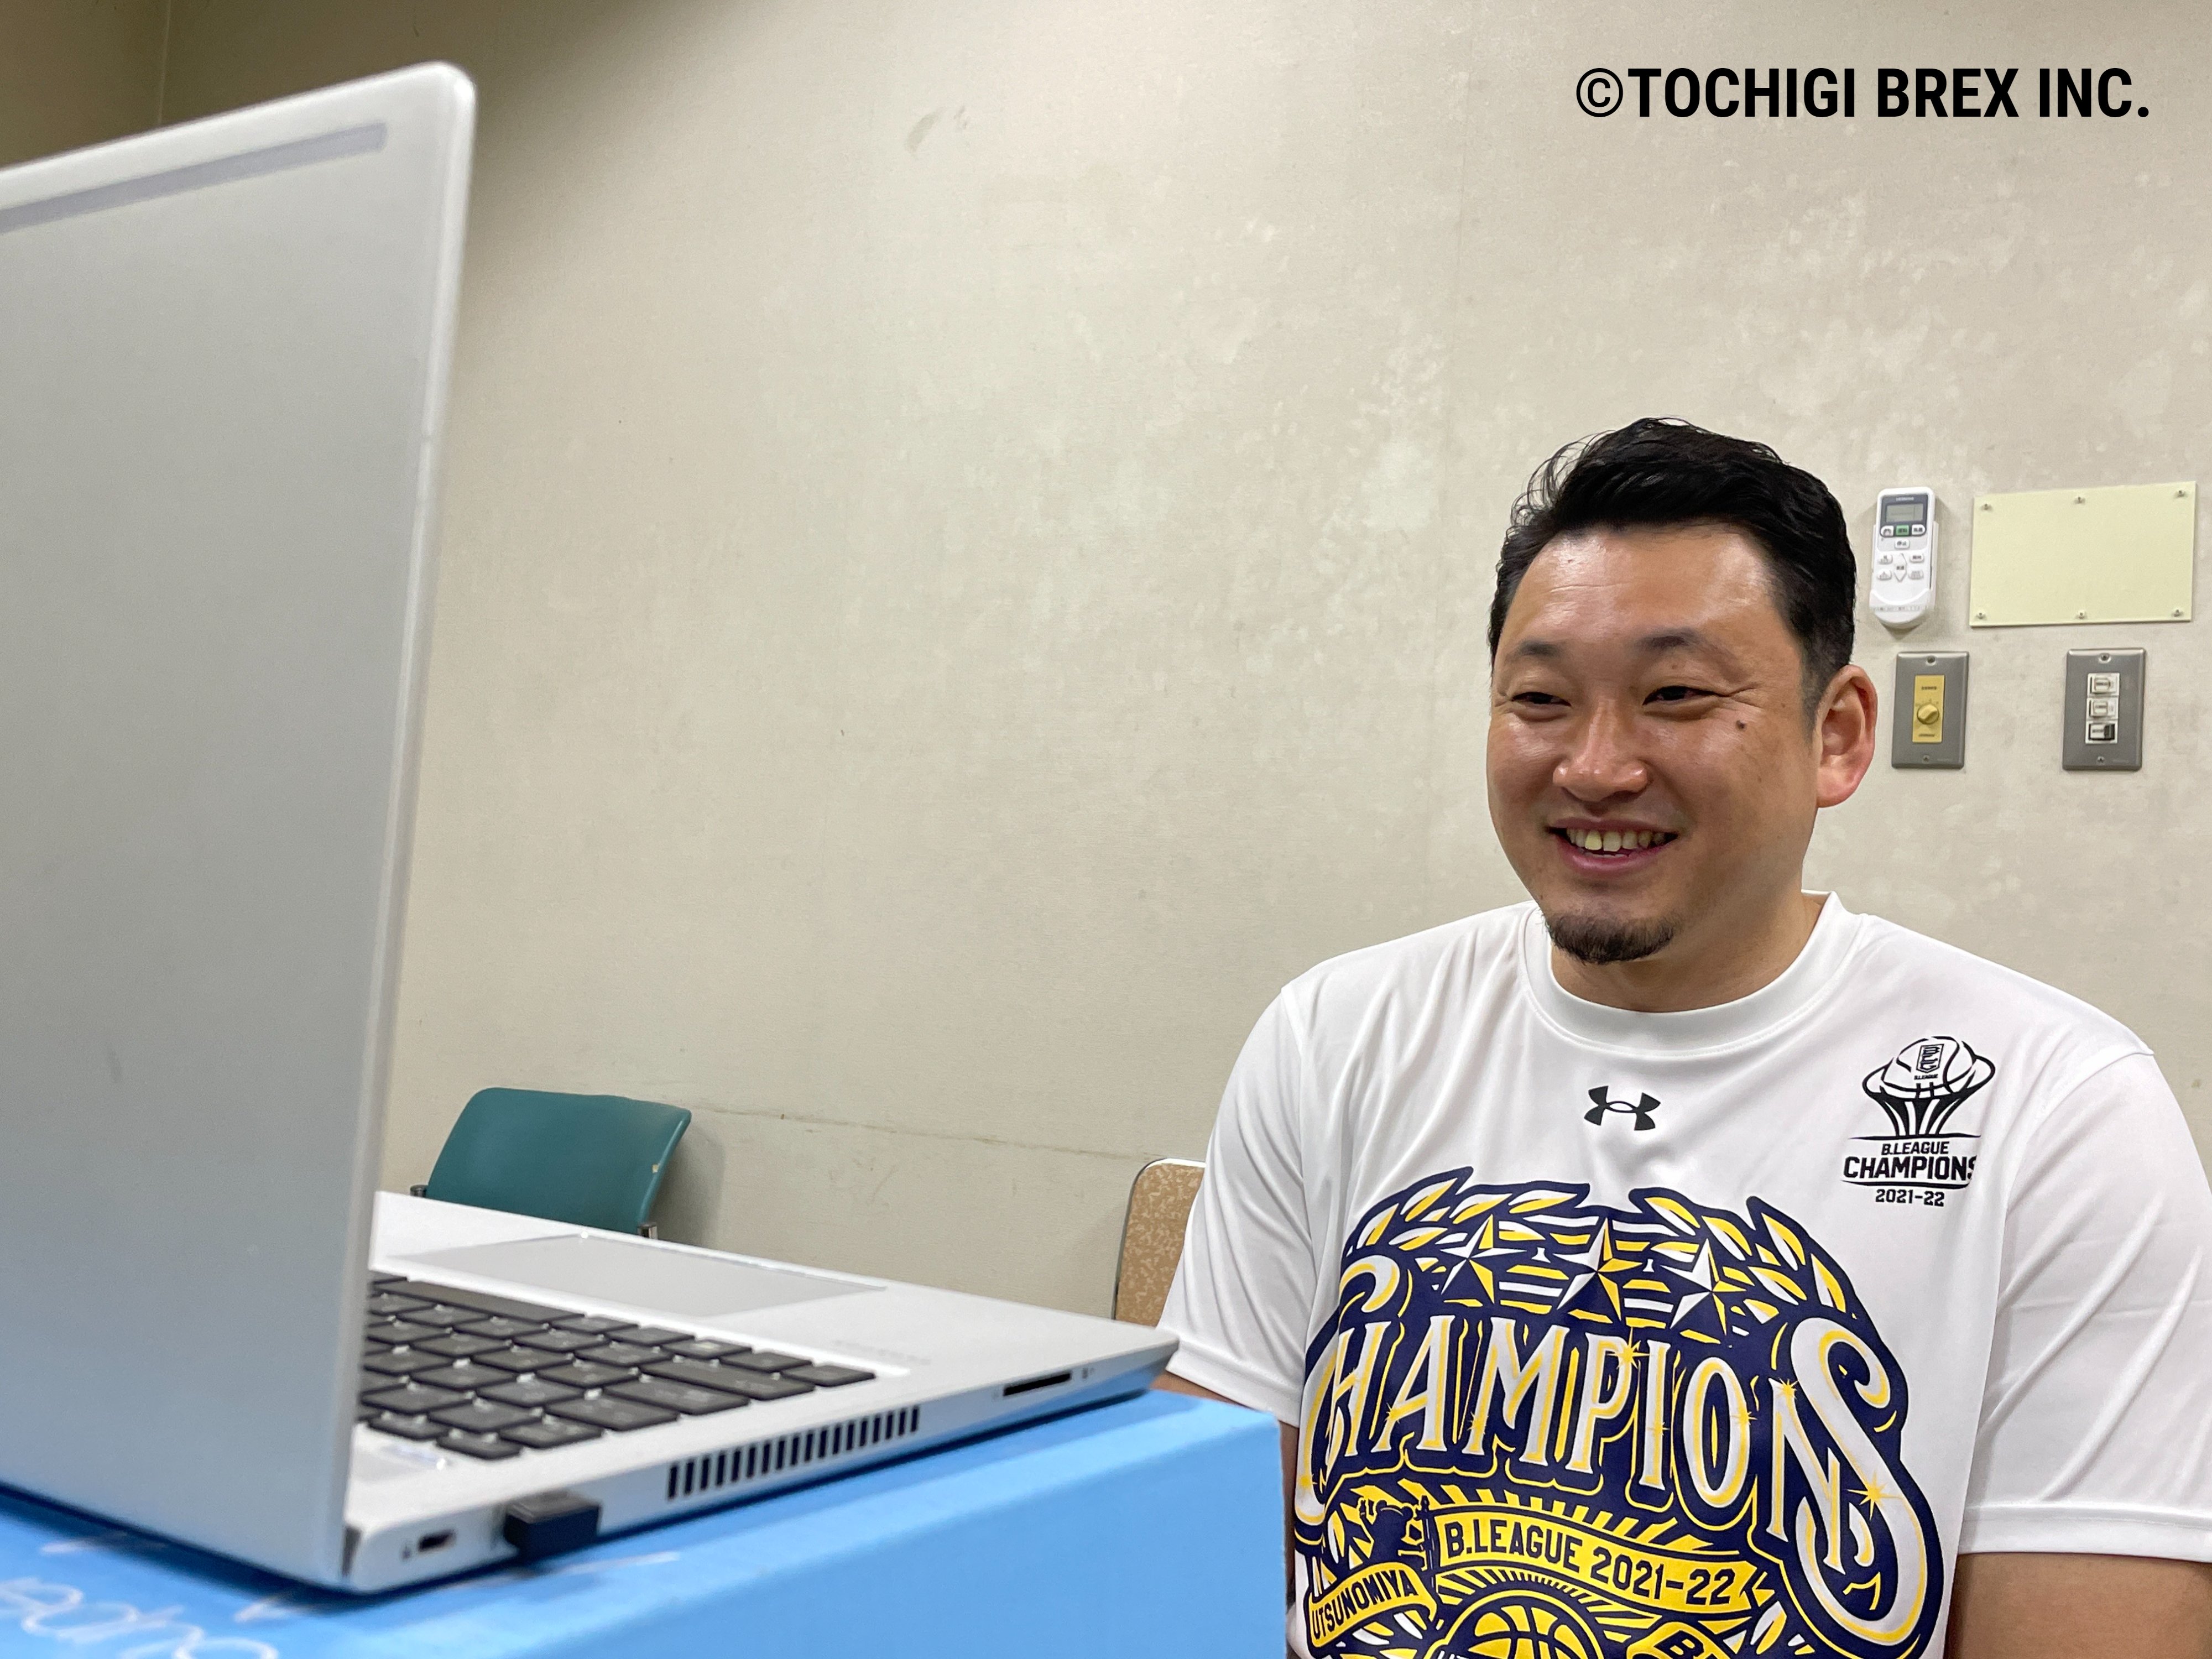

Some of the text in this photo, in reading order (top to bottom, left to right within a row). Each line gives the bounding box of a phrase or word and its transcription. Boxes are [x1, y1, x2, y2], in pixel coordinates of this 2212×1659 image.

[1881, 1141, 1949, 1156] B.LEAGUE
[1875, 1188, 1945, 1207] 2021-22
[1295, 1254, 1930, 1647] CHAMPIONS
[1444, 1519, 1737, 1607] B.LEAGUE 2021-22
[1312, 1569, 1419, 1640] UTSUNOMIYA
